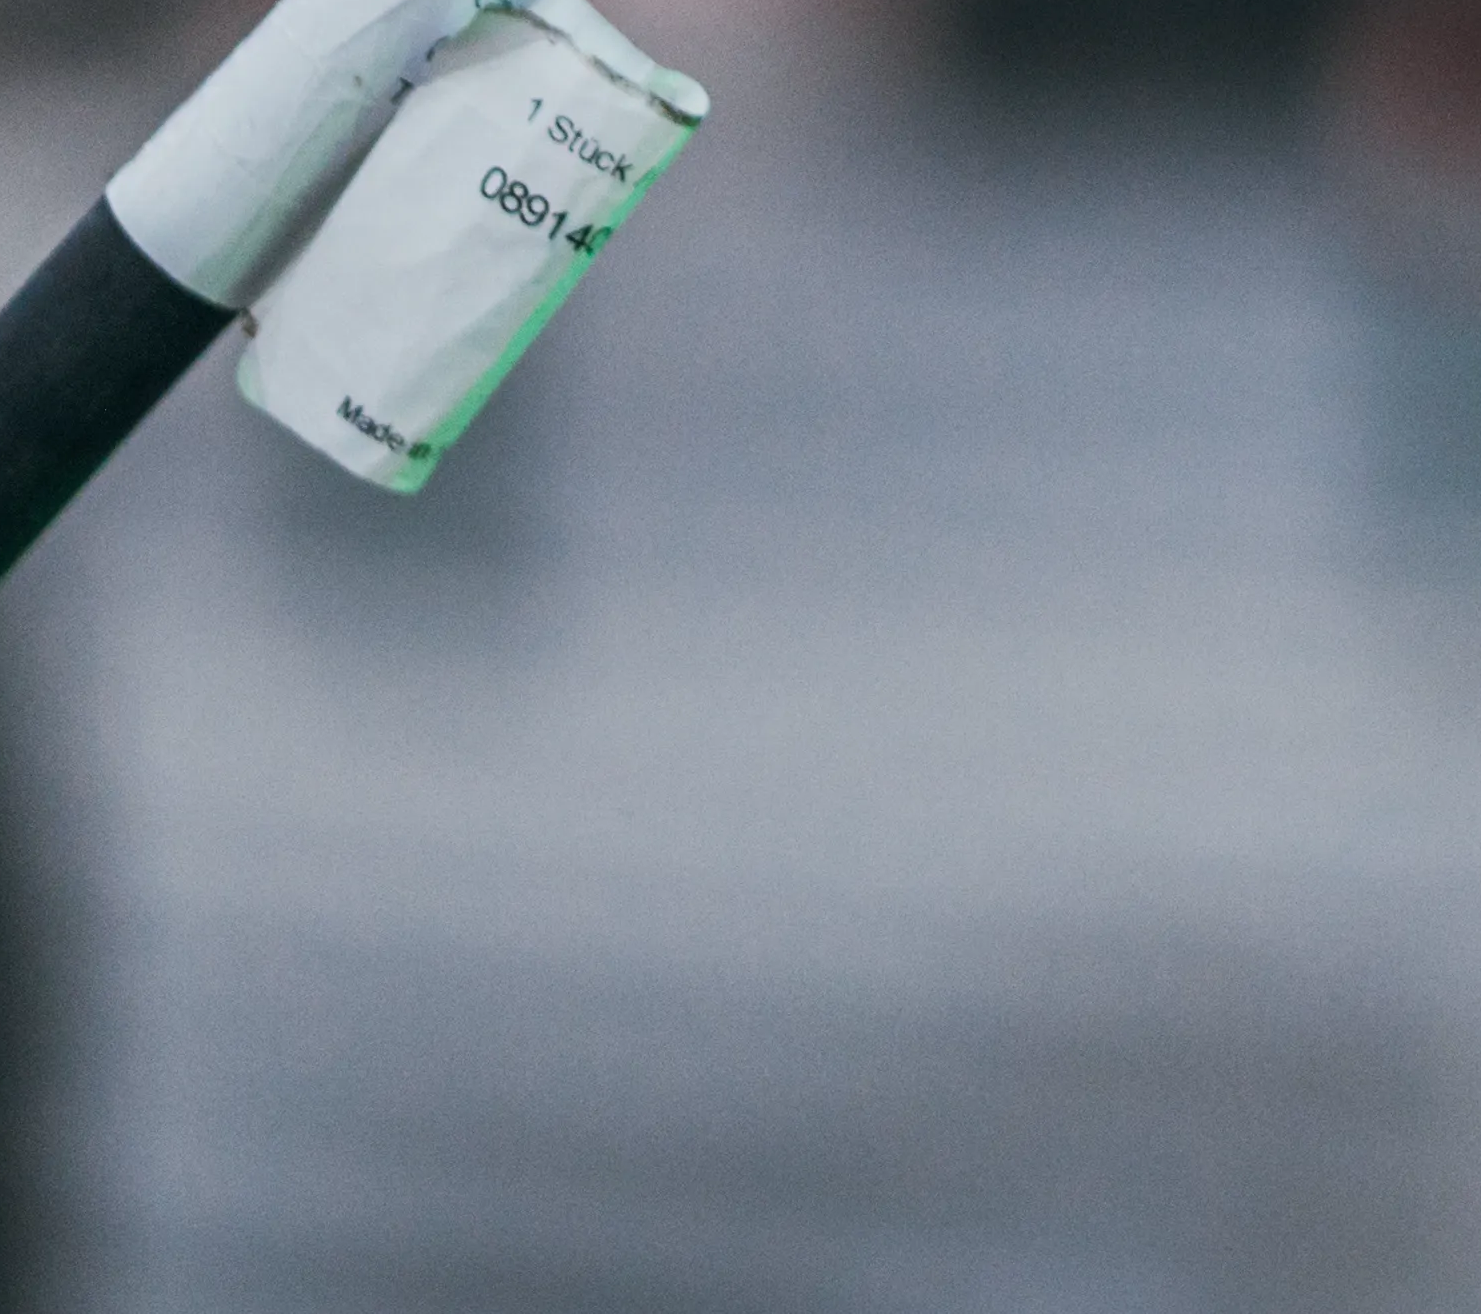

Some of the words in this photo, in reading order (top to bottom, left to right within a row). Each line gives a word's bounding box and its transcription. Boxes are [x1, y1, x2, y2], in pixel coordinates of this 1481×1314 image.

[527, 97, 544, 122] 1
[547, 114, 634, 183] Stück
[336, 394, 406, 453] Made
